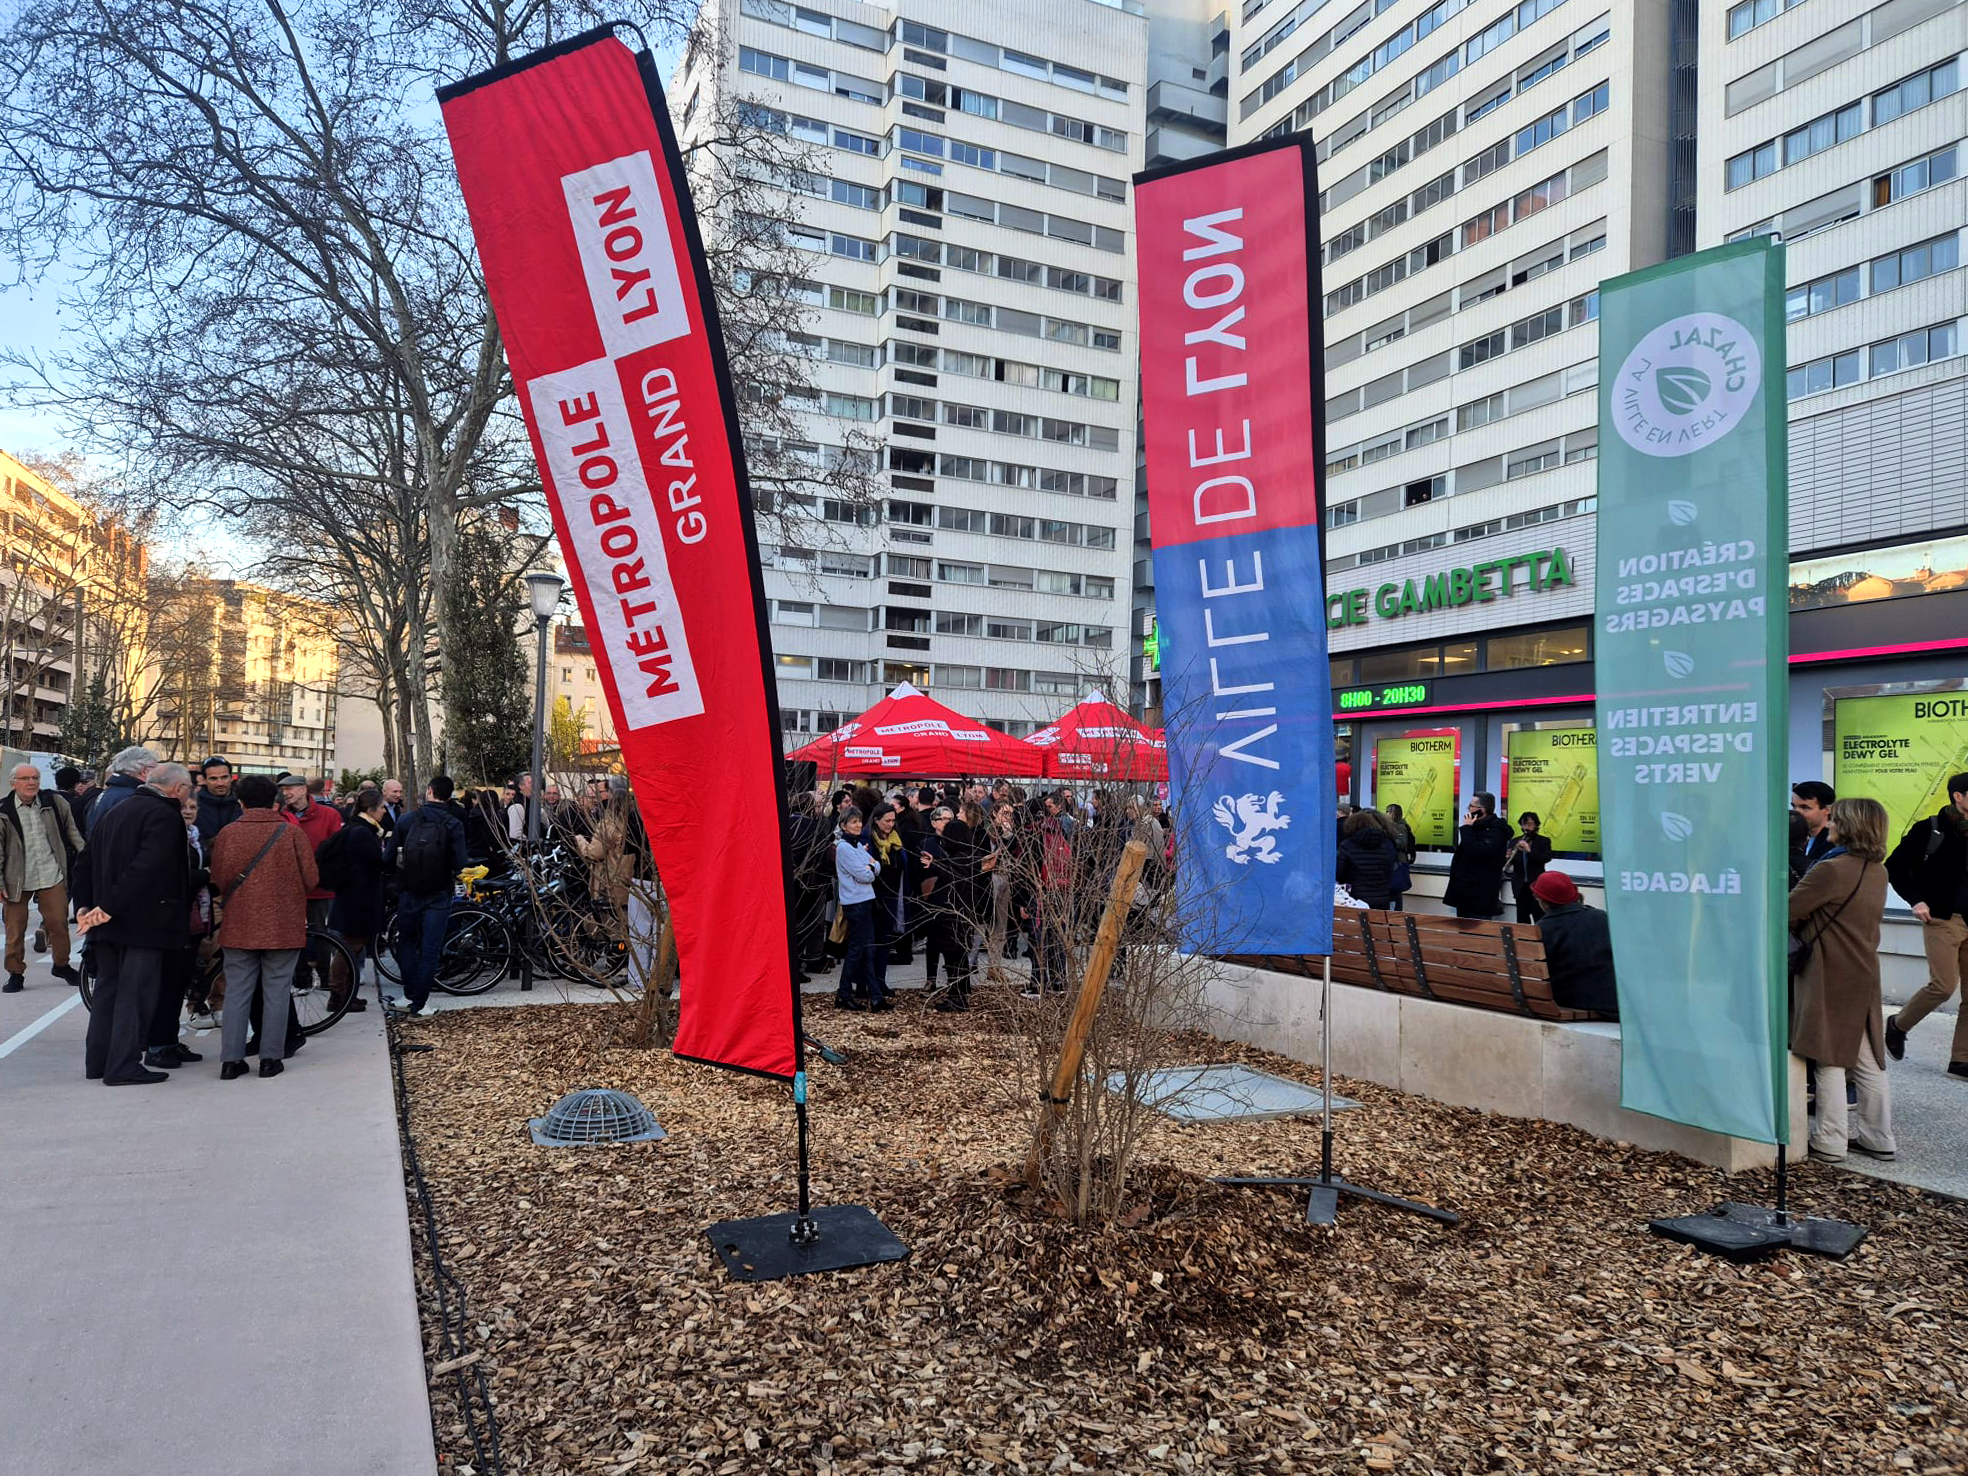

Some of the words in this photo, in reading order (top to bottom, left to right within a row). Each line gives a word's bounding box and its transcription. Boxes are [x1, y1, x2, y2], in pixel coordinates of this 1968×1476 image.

[593, 185, 660, 325] LYON
[641, 367, 707, 544] GRAND
[559, 391, 681, 698] MÉTROPOLE
[1327, 588, 1369, 629] CIE
[1374, 547, 1575, 618] GAMBETTA
[1340, 691, 1372, 708] 8H00
[1383, 686, 1426, 705] 20H30
[1410, 741, 1452, 752] BIOTHERM
[1552, 733, 1597, 747] BIOTHER
[1843, 738, 1911, 750] ELECTROLYTE
[1843, 750, 1875, 759] DEWY
[1879, 749, 1899, 758] GEL
